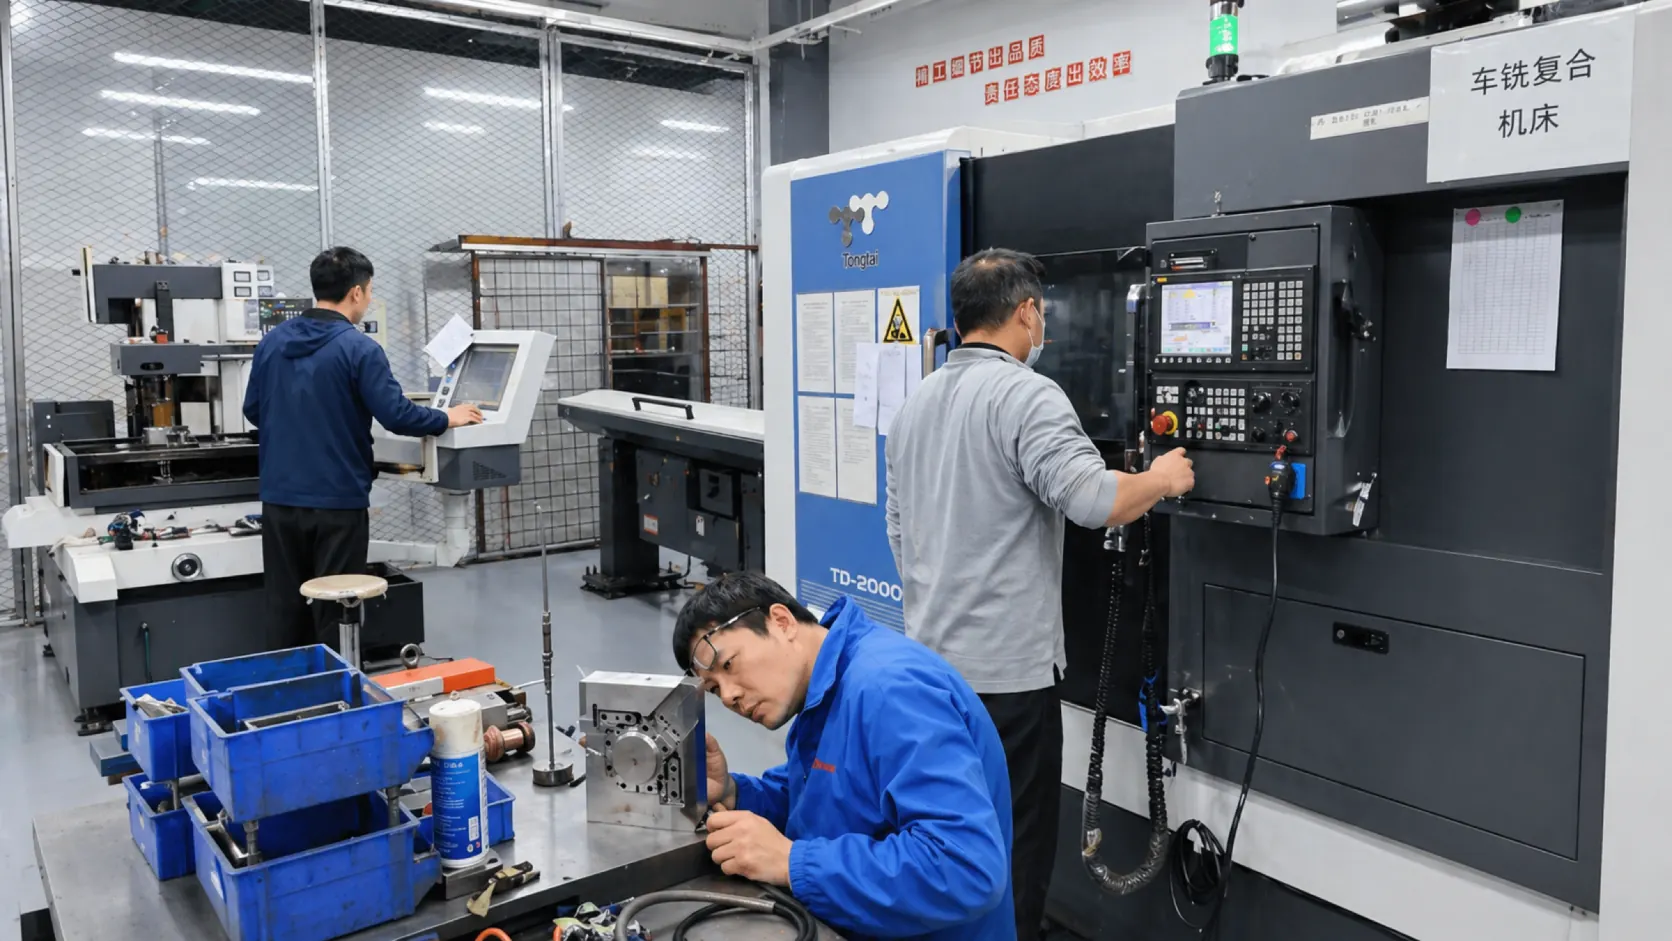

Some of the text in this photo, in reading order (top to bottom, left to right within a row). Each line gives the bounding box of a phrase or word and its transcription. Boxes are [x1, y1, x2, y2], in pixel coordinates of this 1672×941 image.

[984, 51, 1132, 105] 责任态度出效率
[1470, 48, 1596, 96] 车铣复合
[1498, 103, 1559, 138] 机床
[842, 251, 878, 269] Tongtai
[830, 567, 903, 601] TD-2000
